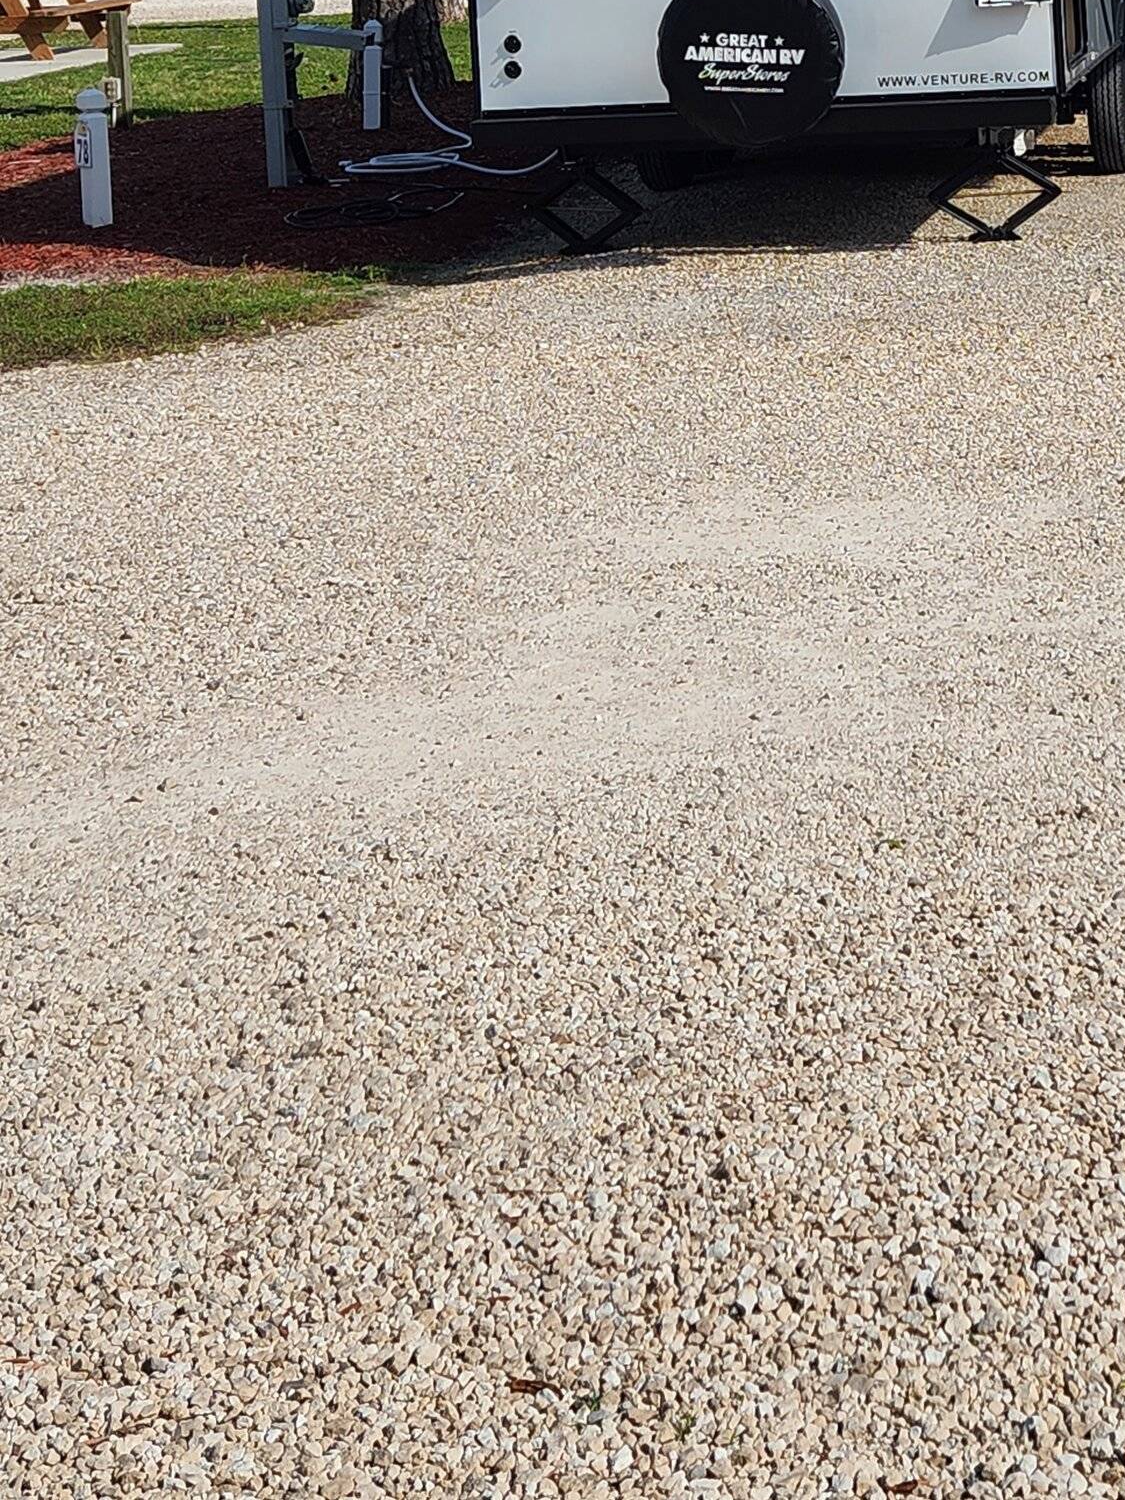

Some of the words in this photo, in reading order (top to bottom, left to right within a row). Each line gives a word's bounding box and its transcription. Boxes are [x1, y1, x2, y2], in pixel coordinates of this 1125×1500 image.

[716, 33, 768, 48] GREAT
[684, 45, 777, 64] AMERICAN
[779, 48, 805, 65] RV
[877, 71, 1050, 88] WWW.VENTURE-RV.COM
[77, 138, 89, 164] 78
